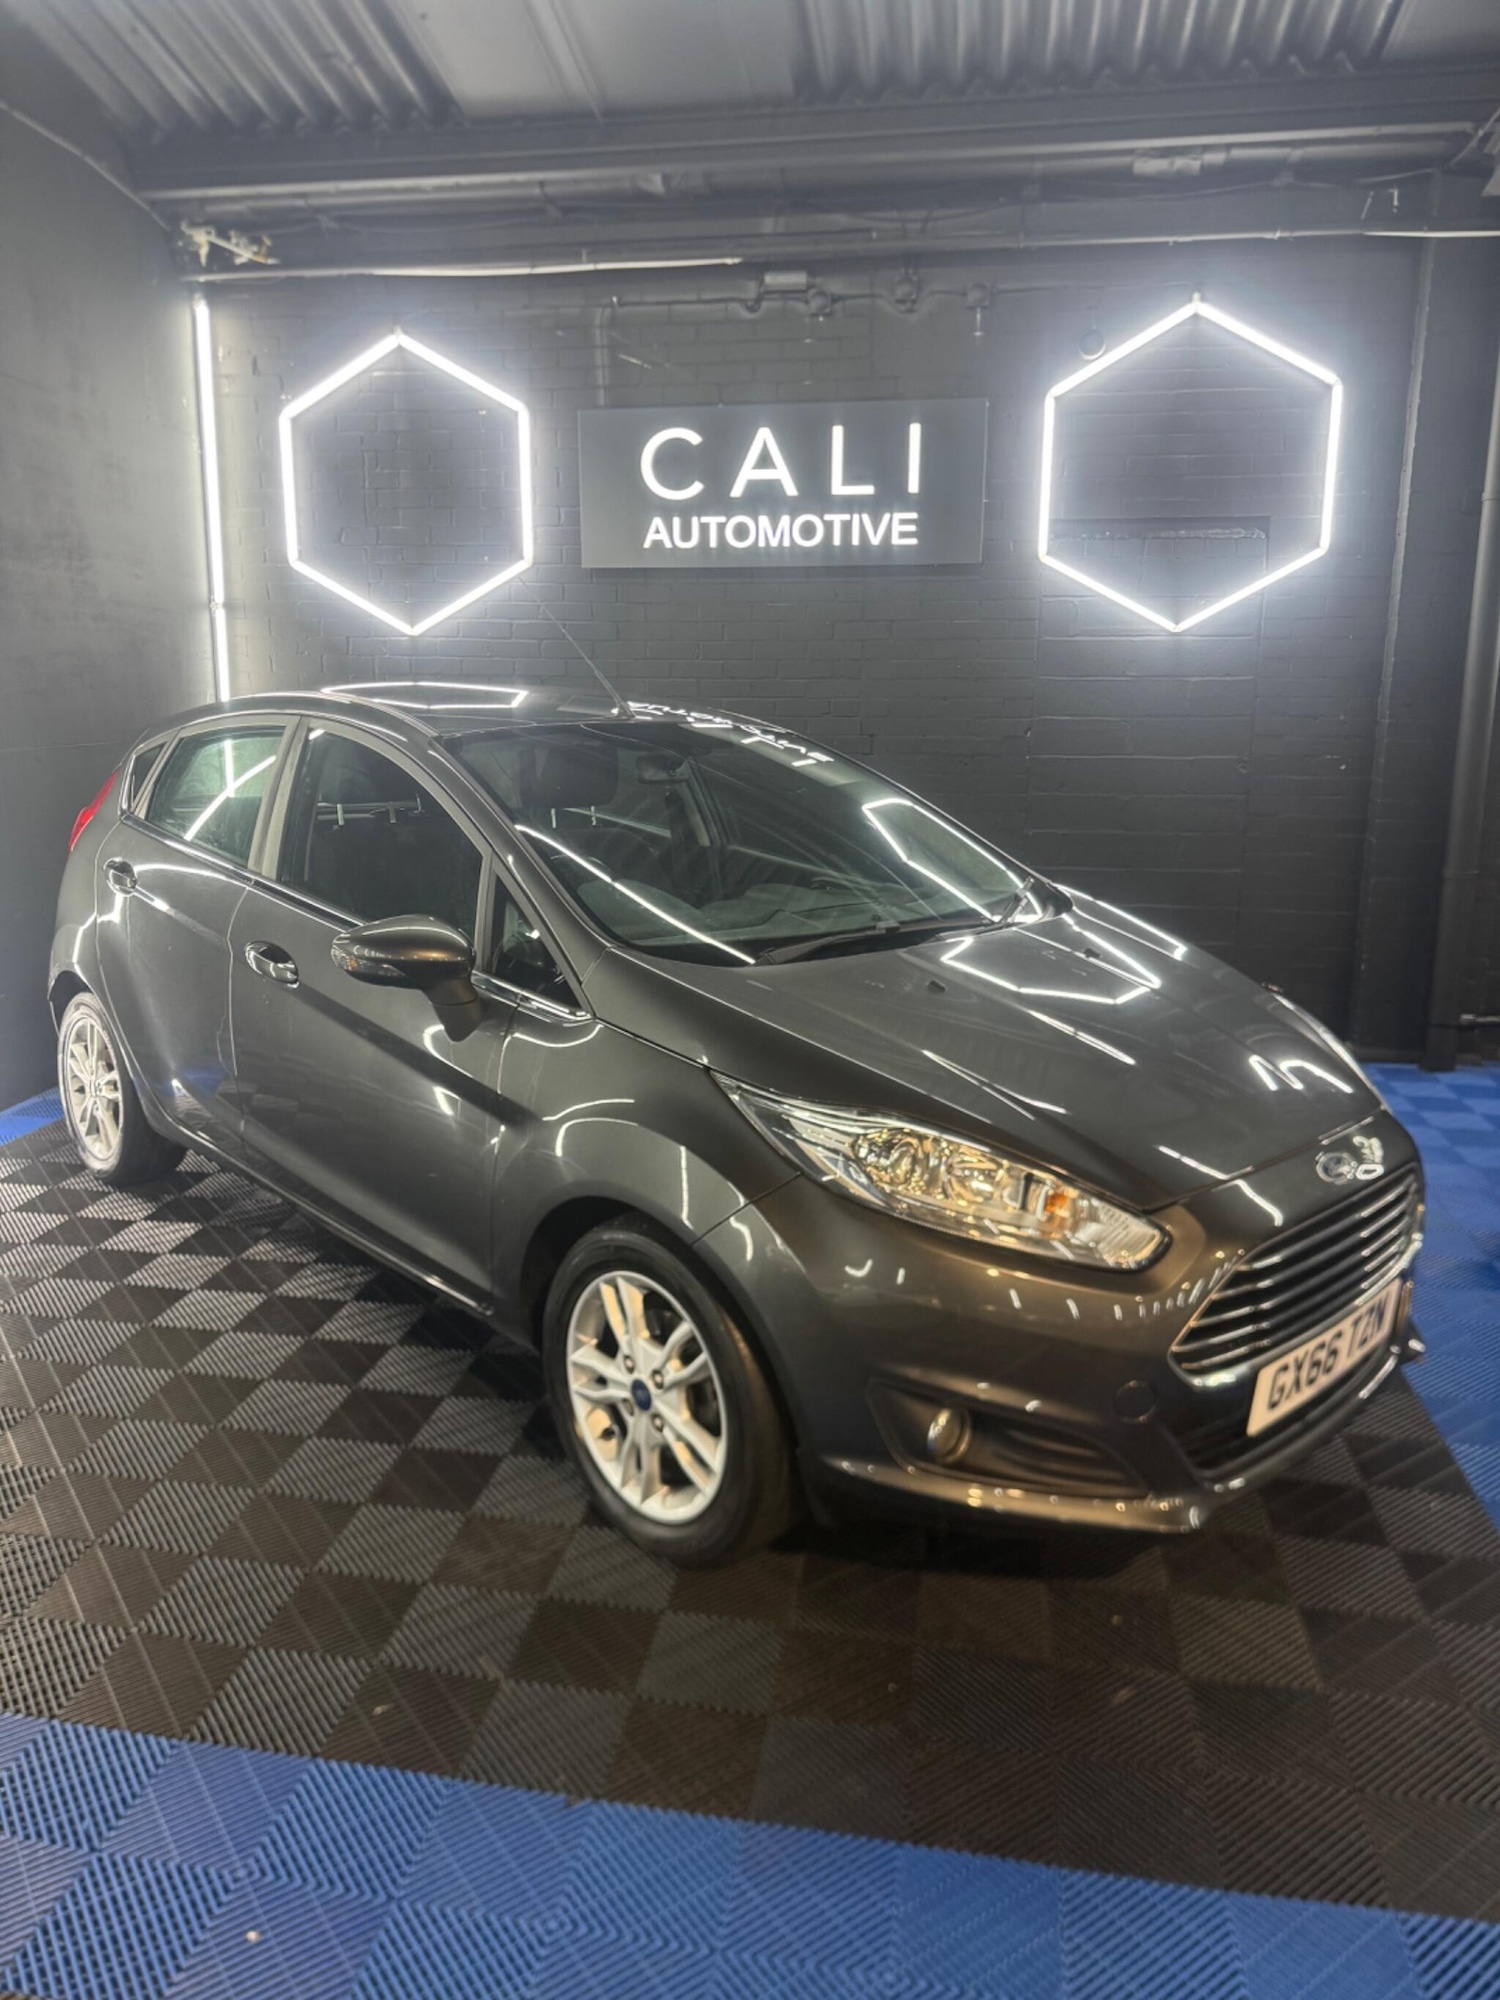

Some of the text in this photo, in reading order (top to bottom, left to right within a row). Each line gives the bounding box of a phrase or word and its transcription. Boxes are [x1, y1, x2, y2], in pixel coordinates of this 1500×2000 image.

[640, 422, 922, 501] CALI
[642, 512, 920, 549] AUTOMOTIVE
[1267, 1289, 1390, 1411] GX66 TZN
